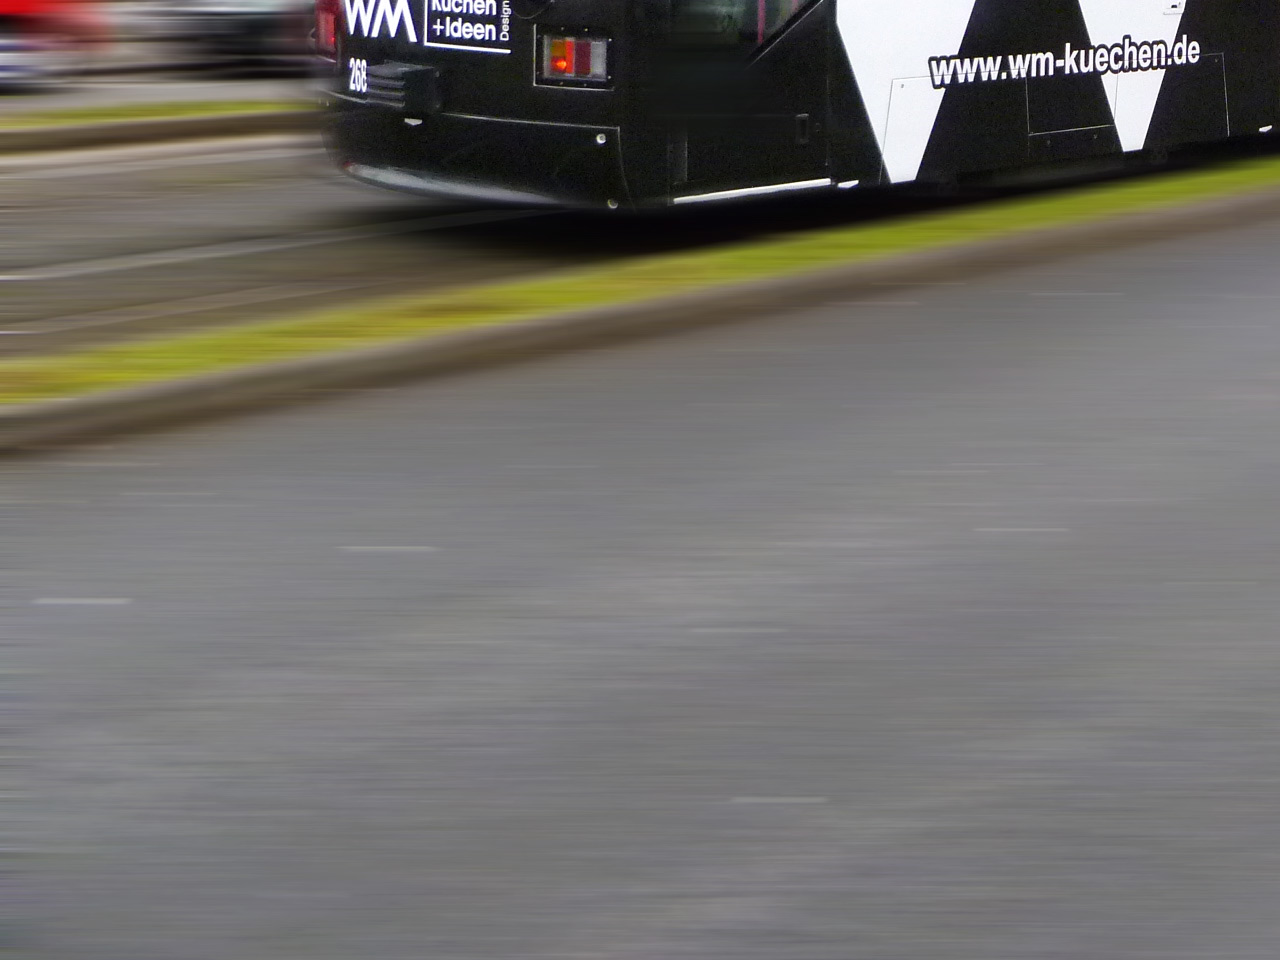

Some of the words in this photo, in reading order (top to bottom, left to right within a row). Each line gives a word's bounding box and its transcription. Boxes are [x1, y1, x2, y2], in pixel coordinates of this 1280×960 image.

[433, 16, 497, 41] +Ideen
[500, 0, 512, 41] Design
[350, 57, 368, 93] 268
[930, 34, 1200, 87] www.wm-kuechen.de
